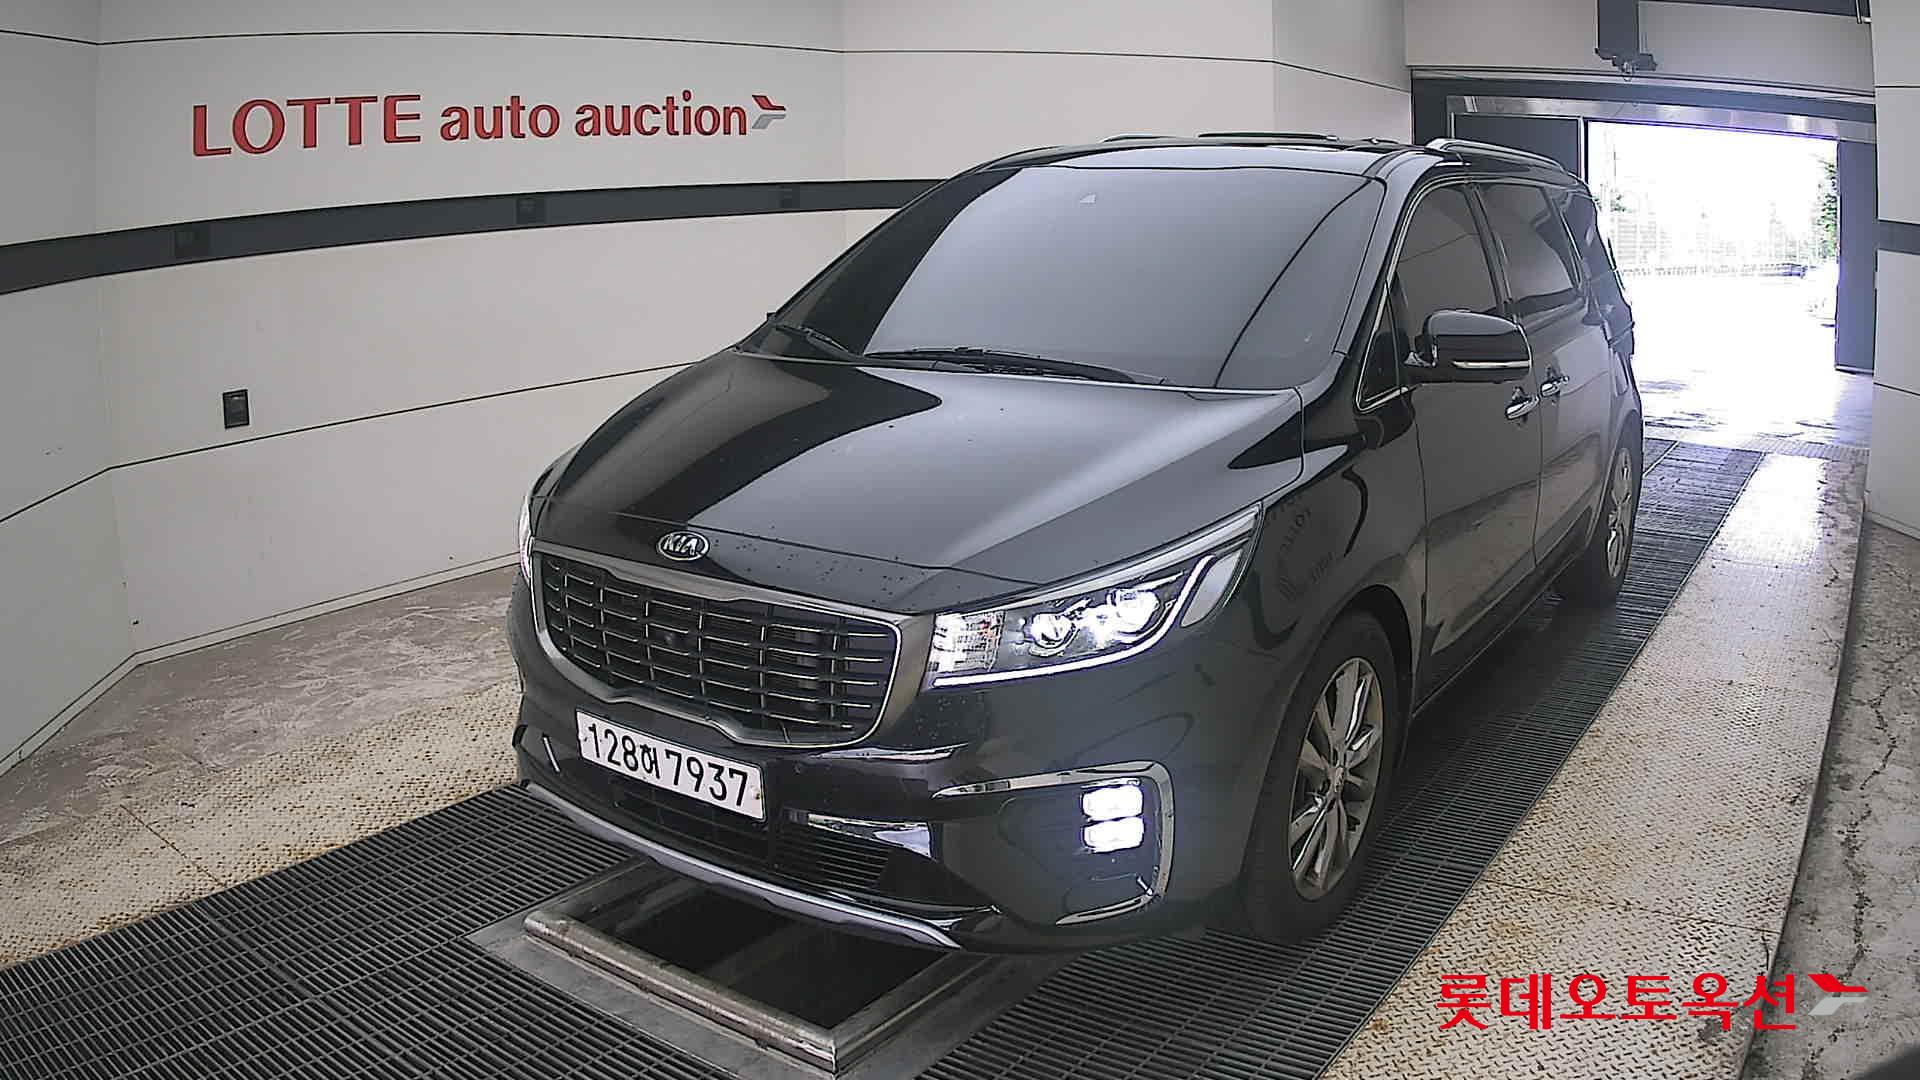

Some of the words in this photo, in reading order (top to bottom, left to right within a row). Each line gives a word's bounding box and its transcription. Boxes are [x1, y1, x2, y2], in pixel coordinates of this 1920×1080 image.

[192, 94, 421, 157] LOTTE
[440, 95, 560, 141] auto
[574, 89, 748, 137] auction
[662, 532, 699, 556] KIA
[665, 748, 749, 807] 7937
